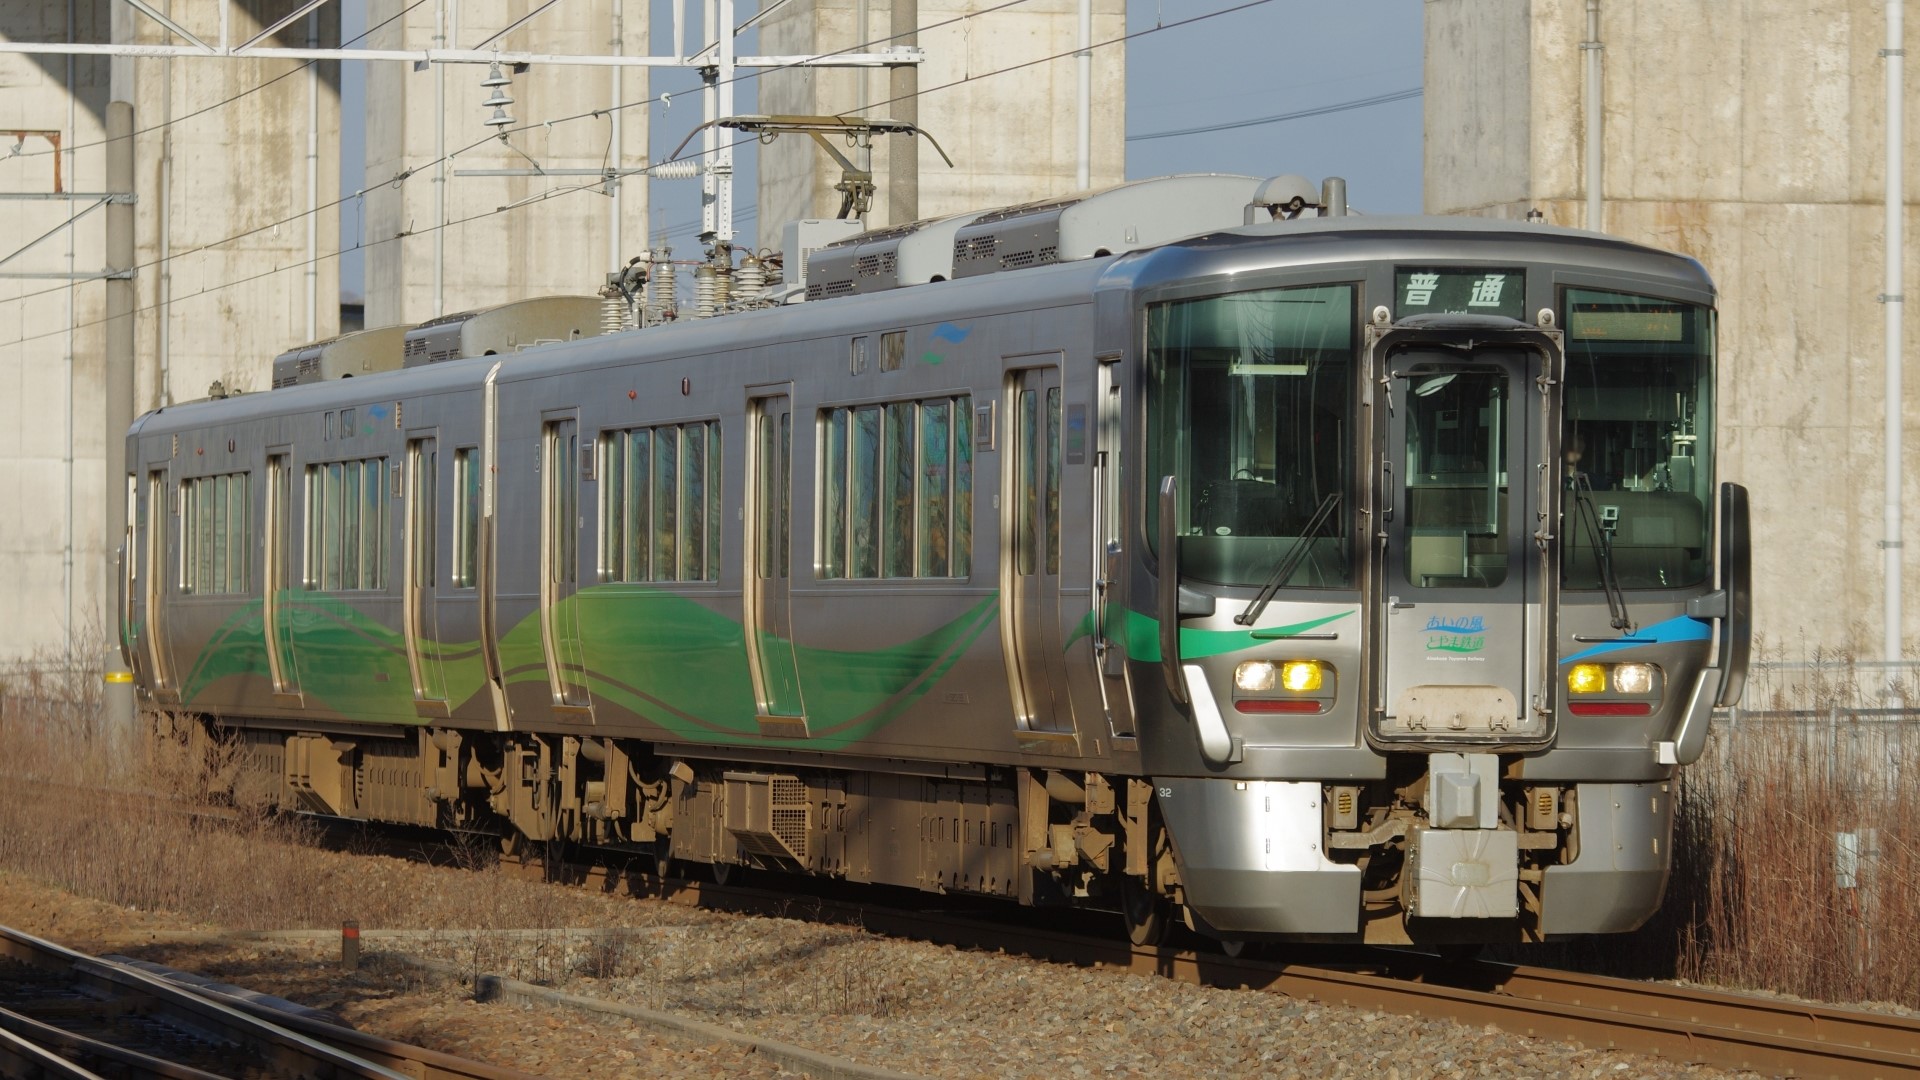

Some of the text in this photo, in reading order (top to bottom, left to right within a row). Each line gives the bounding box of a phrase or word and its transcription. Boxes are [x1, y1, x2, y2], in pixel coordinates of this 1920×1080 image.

[1405, 272, 1506, 307] 普通
[1425, 615, 1486, 632] あいの風
[1159, 787, 1172, 798] 32
